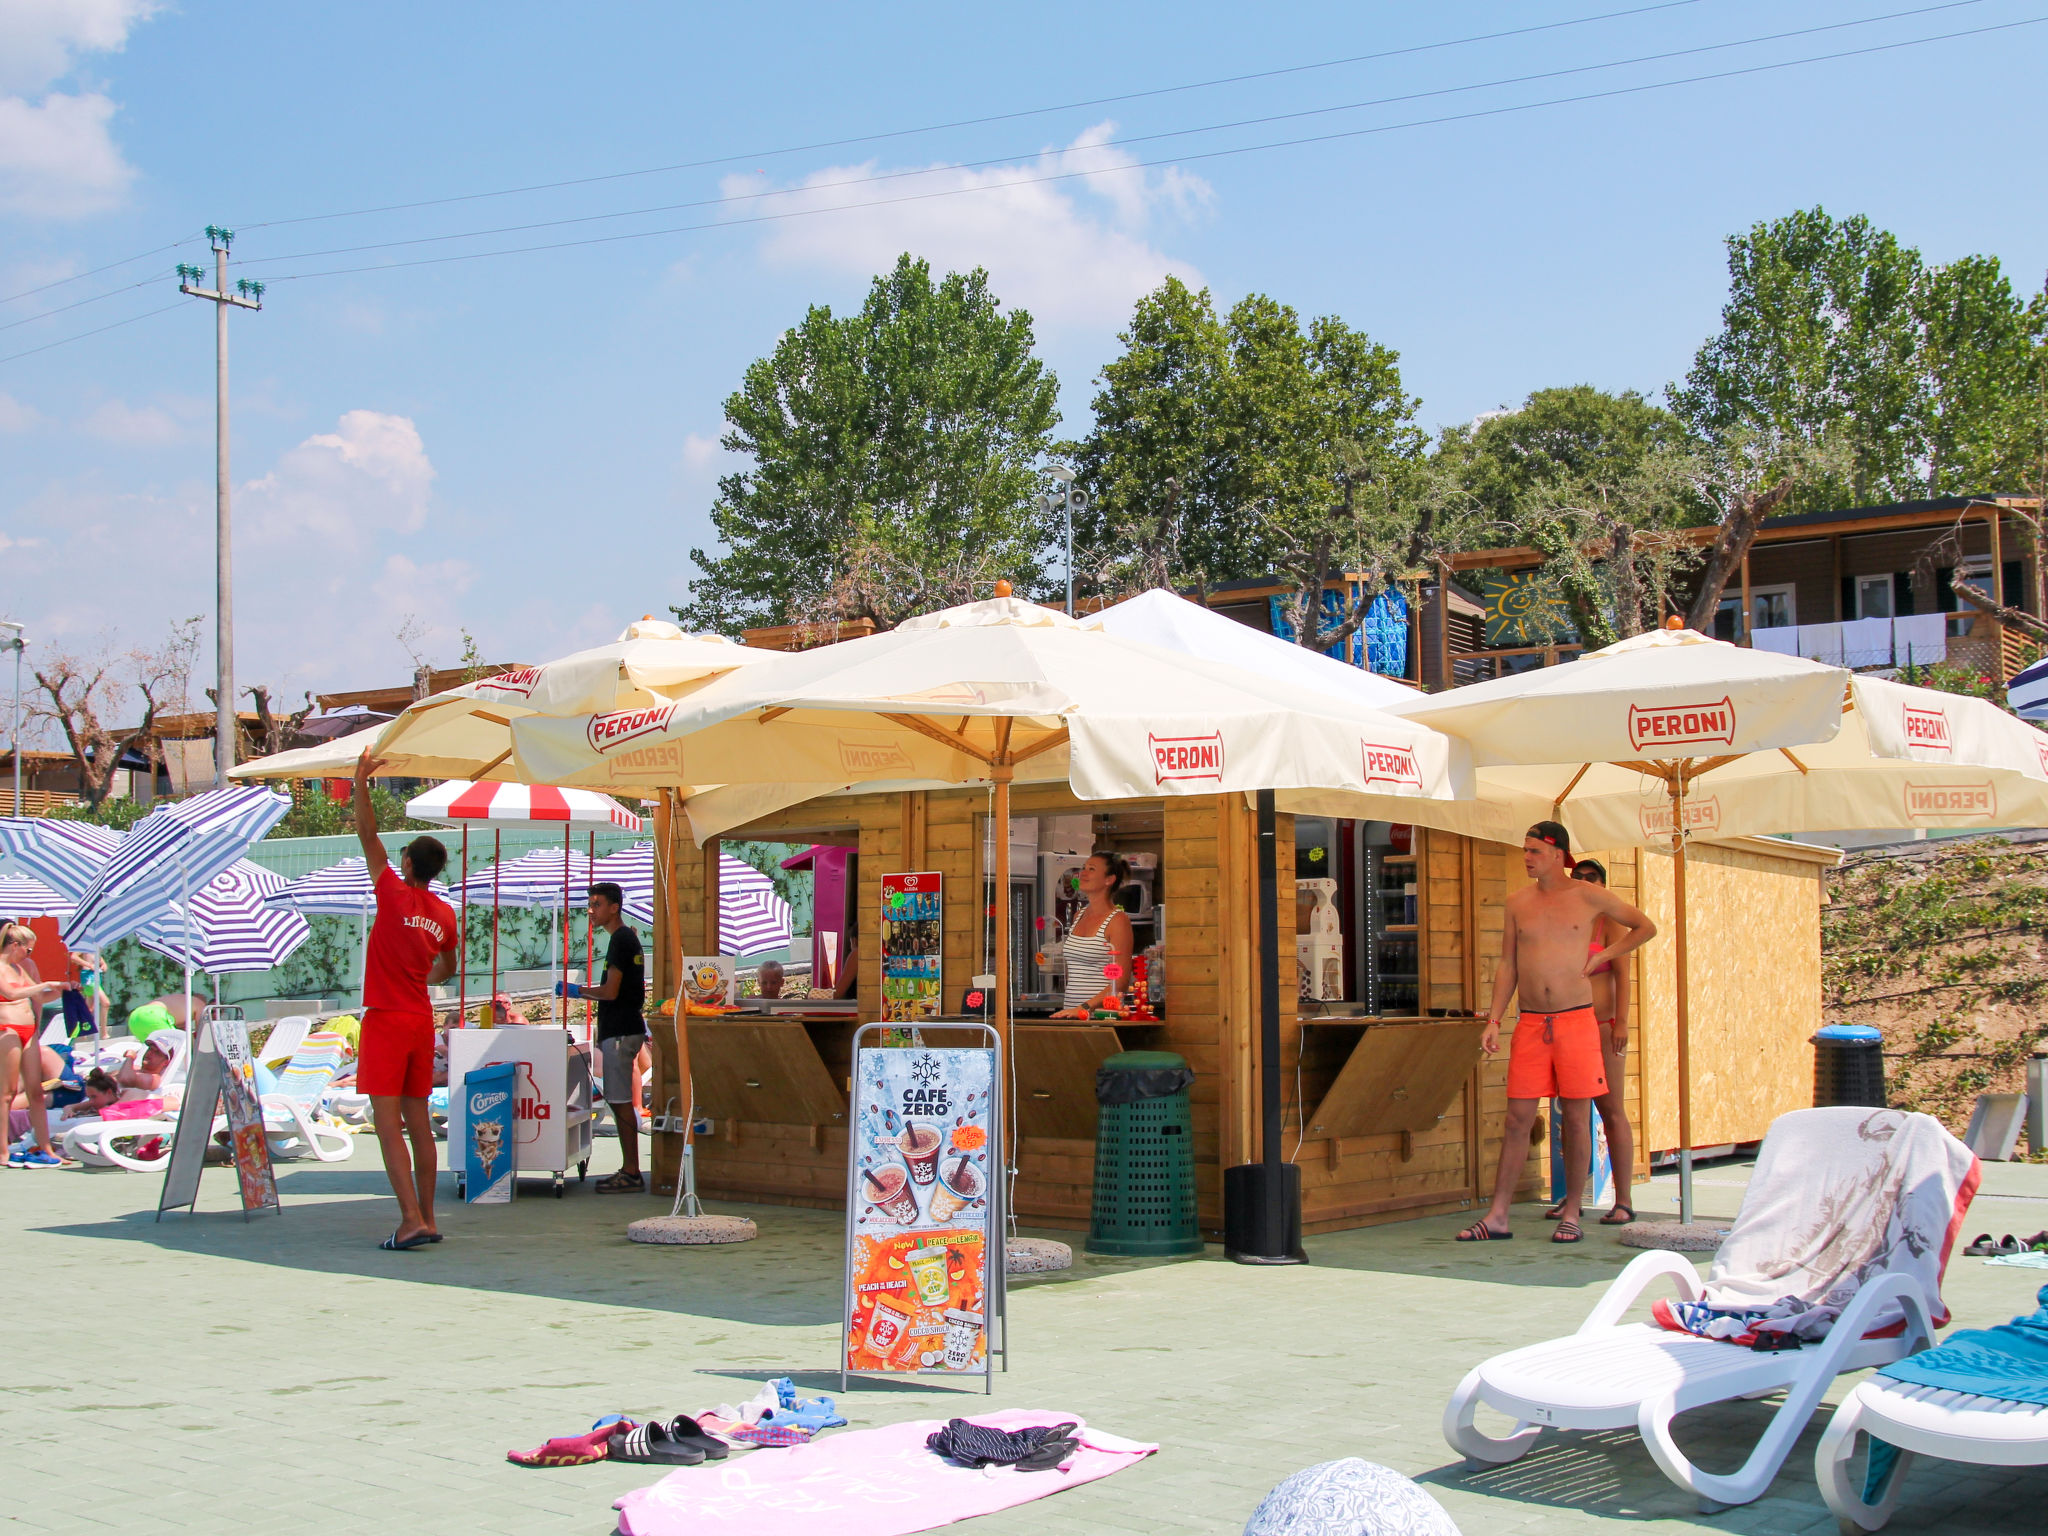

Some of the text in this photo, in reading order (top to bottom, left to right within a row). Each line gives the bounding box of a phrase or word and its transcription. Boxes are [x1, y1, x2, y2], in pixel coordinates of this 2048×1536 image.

[593, 706, 669, 742] PERONI
[1637, 711, 1726, 737] PERONI
[1907, 716, 1947, 740] PERONI
[1155, 745, 1219, 770] PERONI
[1367, 751, 1415, 776] PERONI
[902, 1083, 948, 1103] CAFÉ
[894, 1240, 914, 1250] NOW
[927, 1238, 948, 1246] PEACE
[858, 1282, 880, 1292] PEACH
[948, 1350, 966, 1358] ZERO
